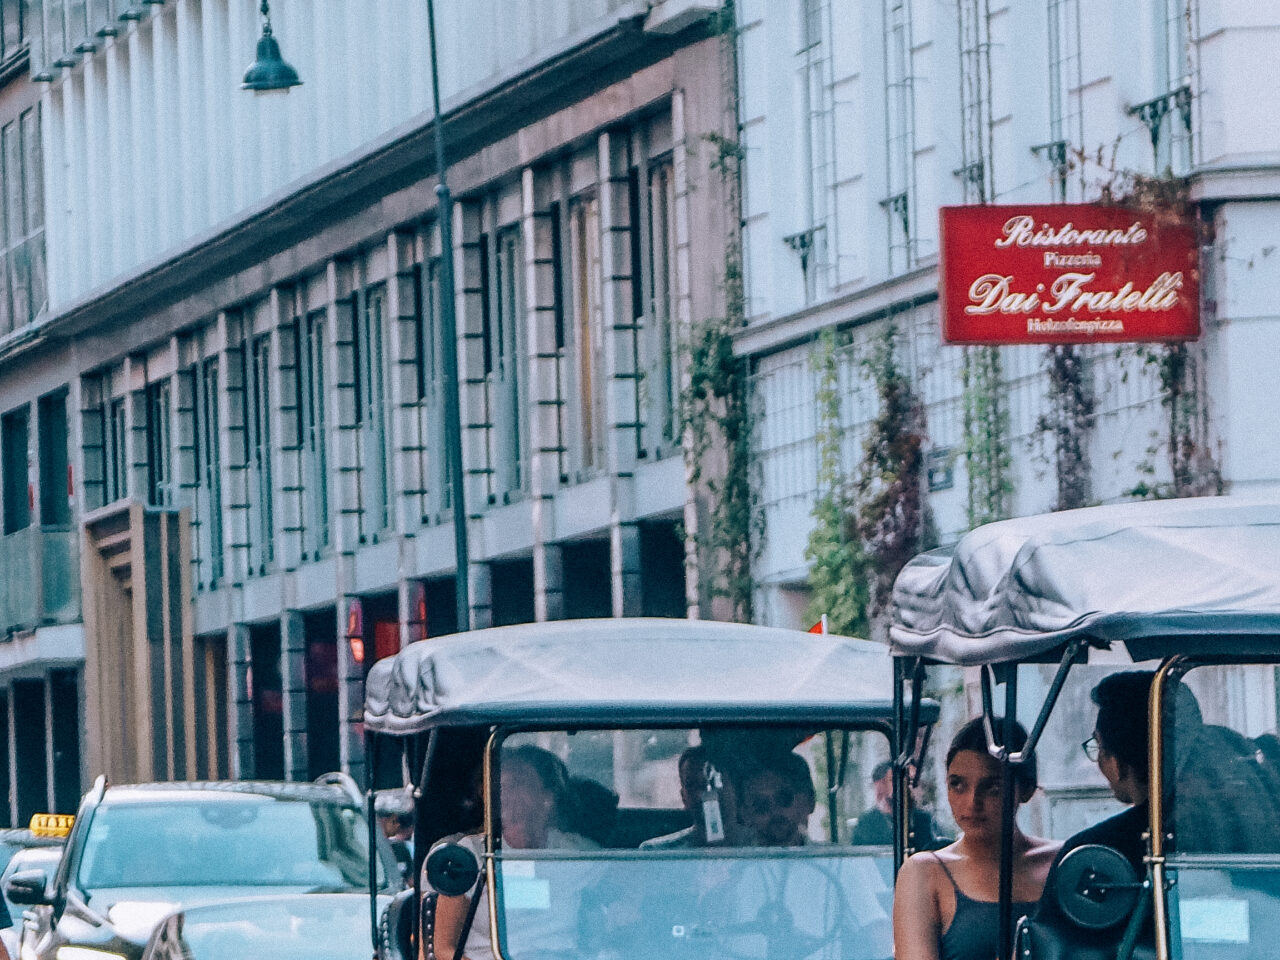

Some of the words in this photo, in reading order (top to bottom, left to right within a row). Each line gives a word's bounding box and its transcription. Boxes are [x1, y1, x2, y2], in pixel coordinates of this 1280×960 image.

[995, 215, 1149, 247] Ristorante
[1044, 251, 1103, 267] Pizzeria
[964, 274, 1045, 315] Dai
[1042, 271, 1184, 313] Fratelli
